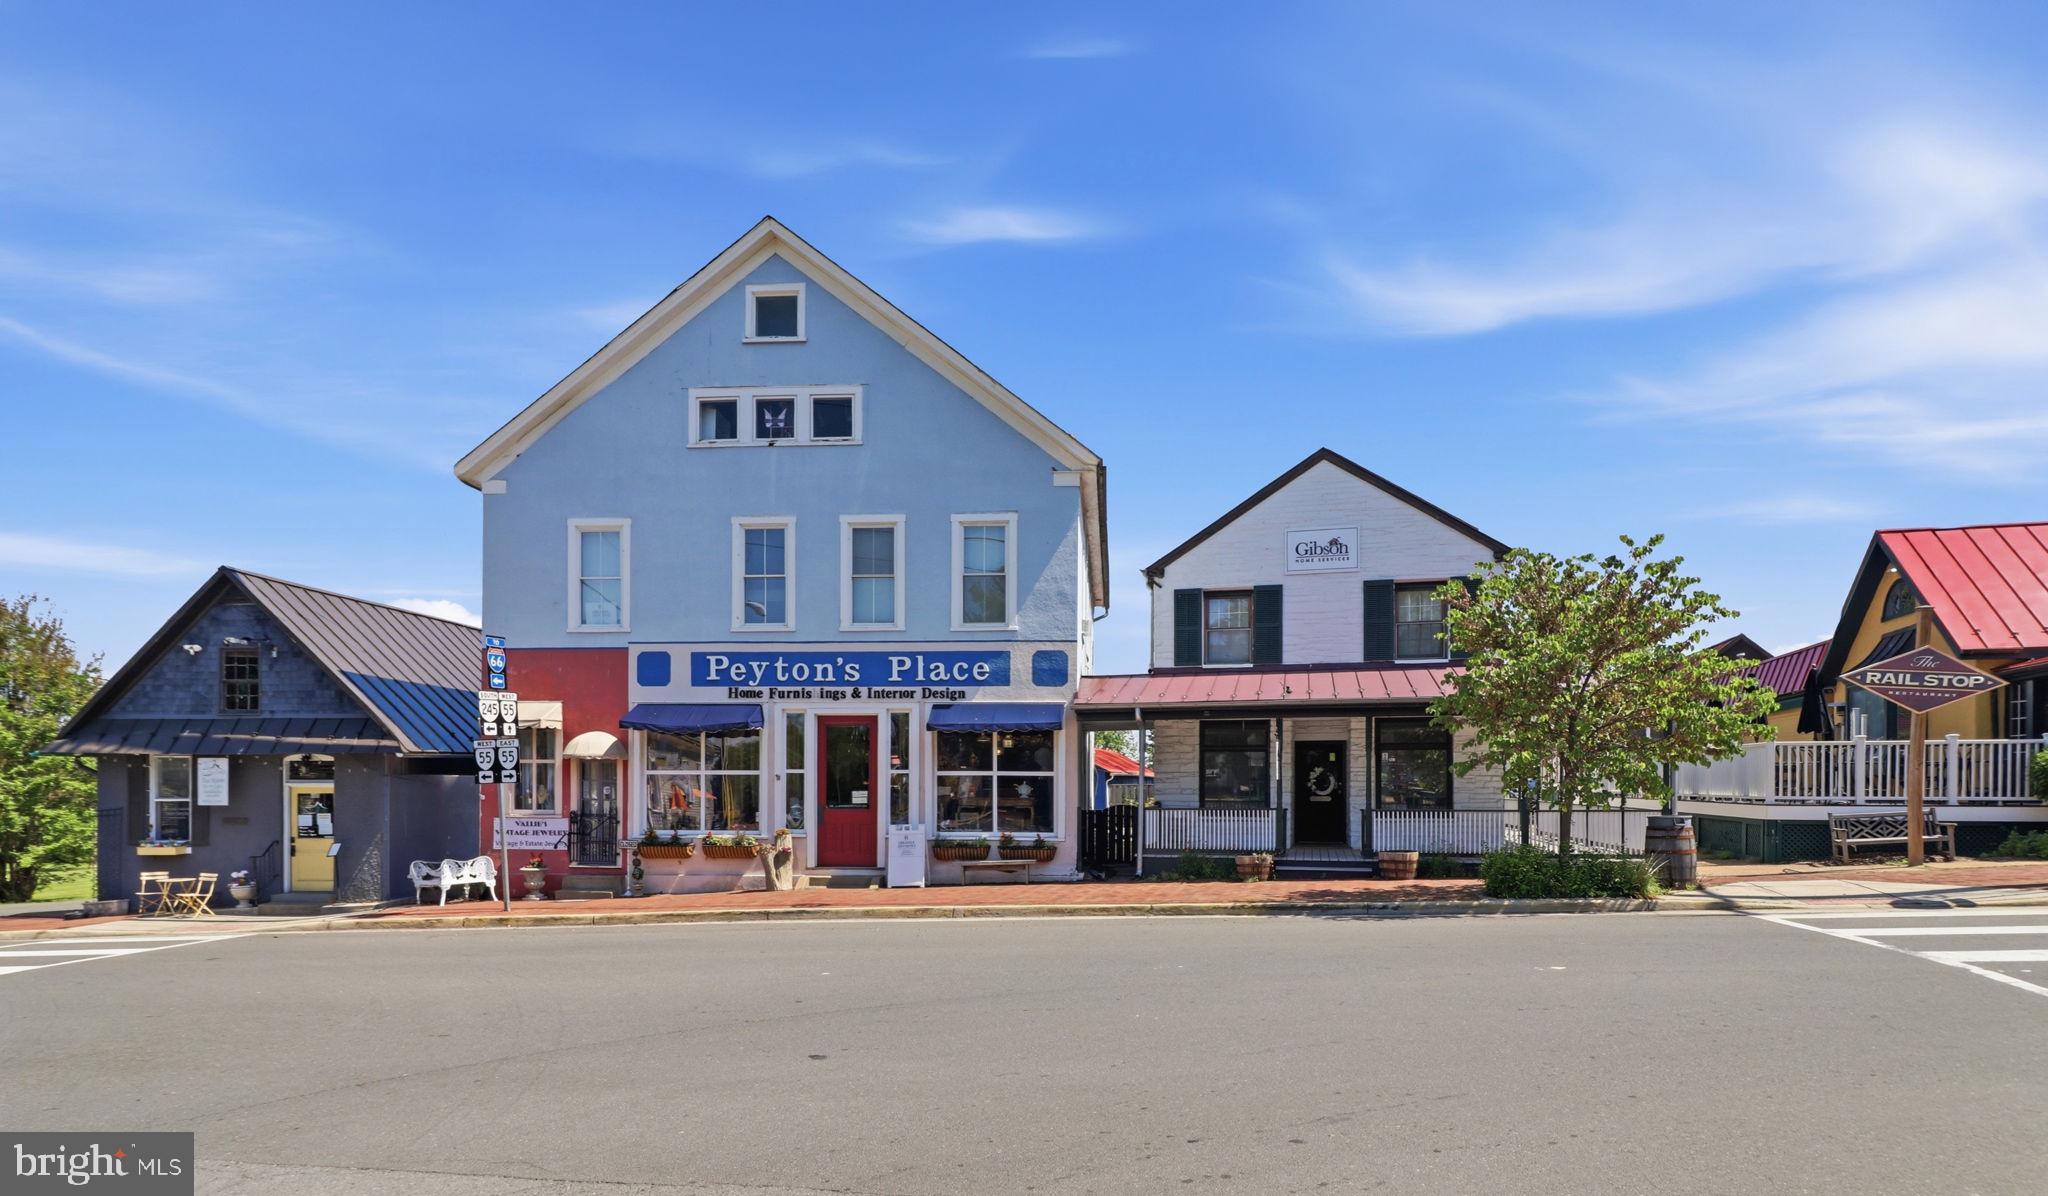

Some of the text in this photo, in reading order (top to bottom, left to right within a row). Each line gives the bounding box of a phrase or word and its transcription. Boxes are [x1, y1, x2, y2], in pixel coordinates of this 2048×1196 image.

[1295, 540, 1349, 556] Gibson
[490, 655, 503, 667] 66
[1910, 655, 1941, 668] The
[706, 655, 990, 686] Peyton's Place
[1865, 672, 1985, 688] RAIL STOP
[728, 687, 763, 699] Home
[851, 687, 862, 699] &
[867, 687, 916, 699] Interior
[921, 687, 966, 700] Design
[481, 703, 498, 716] 245
[503, 703, 514, 716] 55
[479, 751, 492, 764] 55
[501, 750, 515, 763] 55
